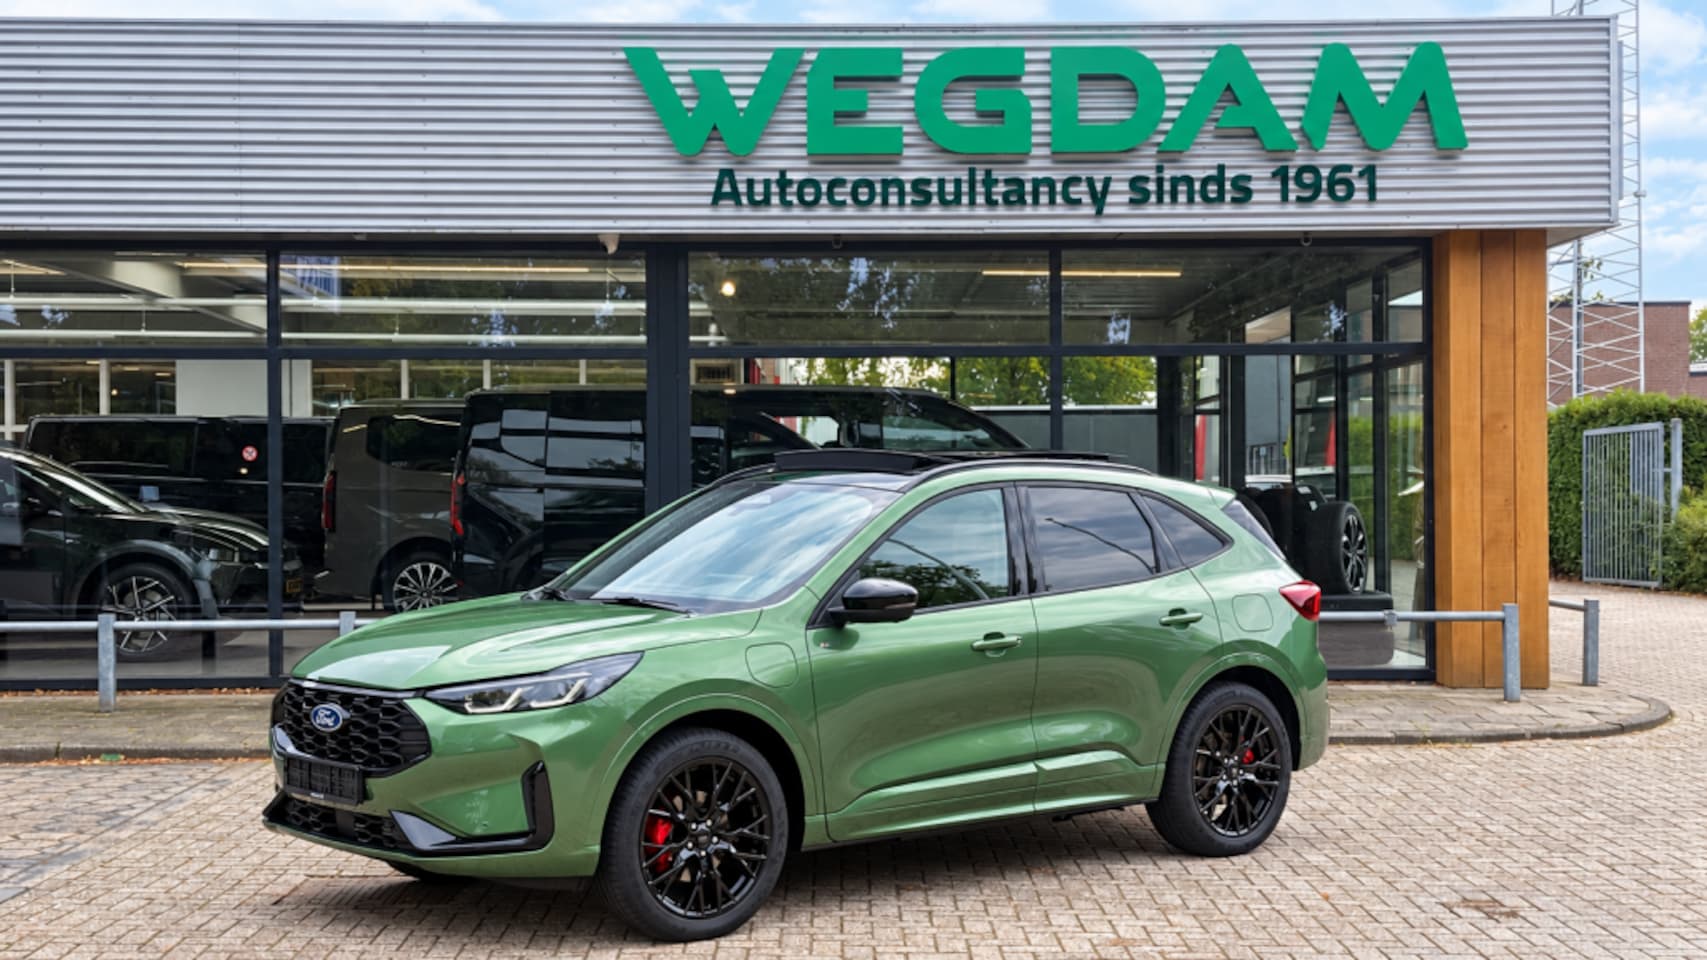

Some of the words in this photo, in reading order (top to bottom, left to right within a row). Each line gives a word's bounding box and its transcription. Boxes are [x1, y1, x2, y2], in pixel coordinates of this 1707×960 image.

[625, 41, 1468, 156] WEGDAM
[711, 167, 1112, 216] Autoconsultancy
[1129, 163, 1252, 206] sinds
[1271, 164, 1379, 203] 1961
